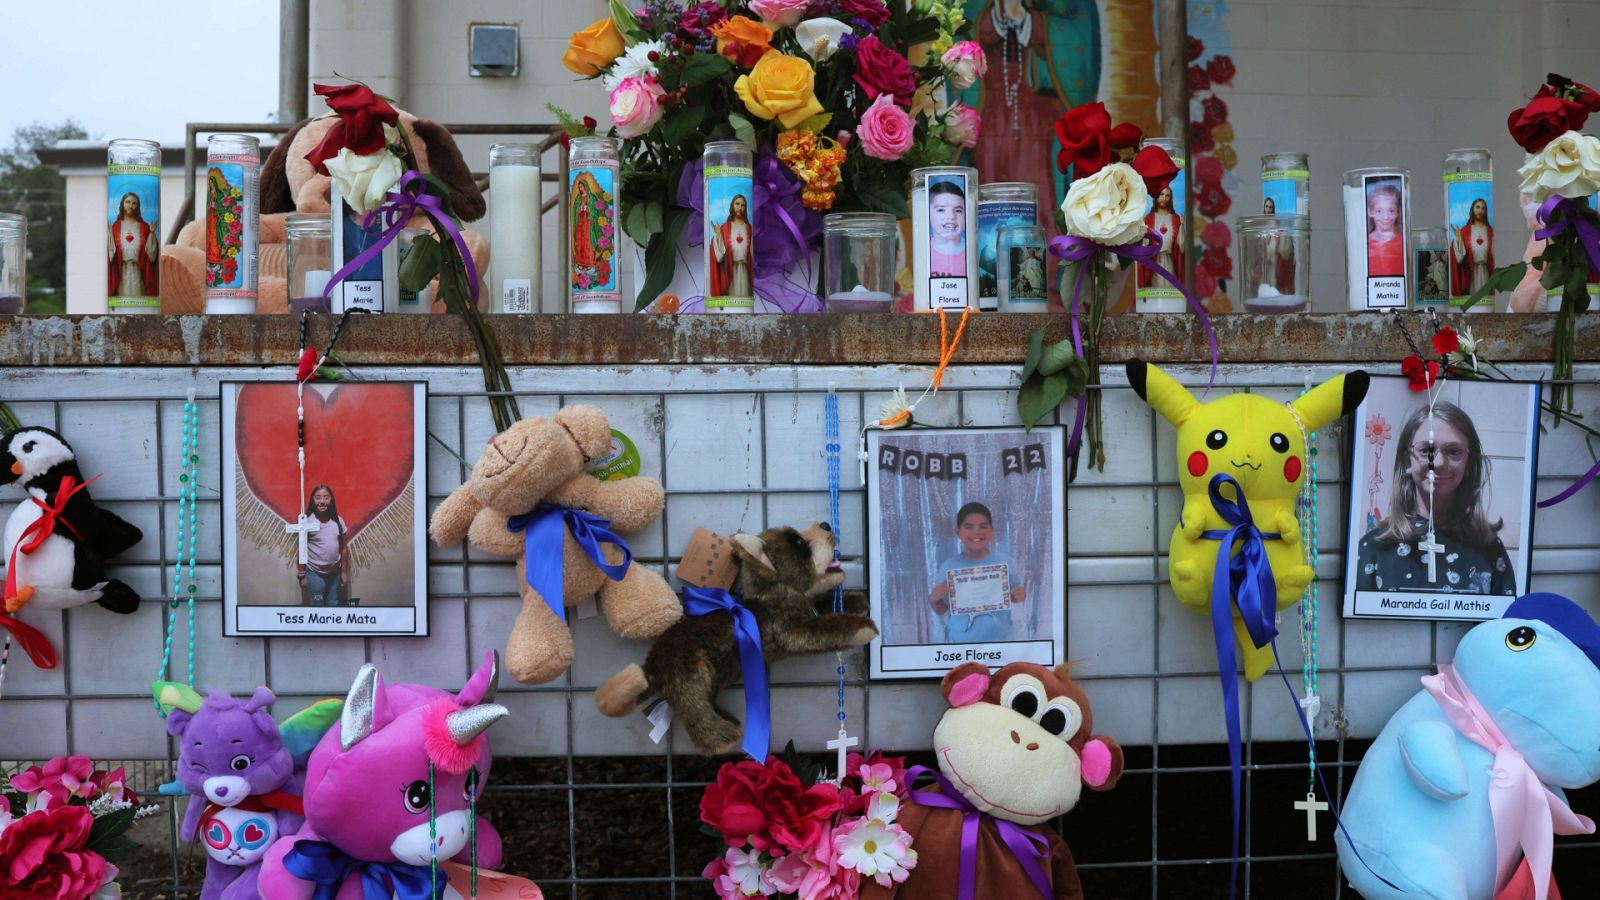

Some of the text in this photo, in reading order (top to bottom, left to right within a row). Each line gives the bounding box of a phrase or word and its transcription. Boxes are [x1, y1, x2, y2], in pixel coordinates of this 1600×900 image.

[354, 284, 371, 292] Tess
[1373, 280, 1401, 288] Miranda
[352, 296, 374, 304] Marie
[938, 296, 960, 304] Flores
[1376, 292, 1400, 300] Mathis
[881, 450, 1041, 473] ROBB 22
[1380, 597, 1491, 611] Maranda Gail Mathis
[276, 612, 377, 624] Tess Marie Mata
[934, 649, 1002, 662] Jose Flores
